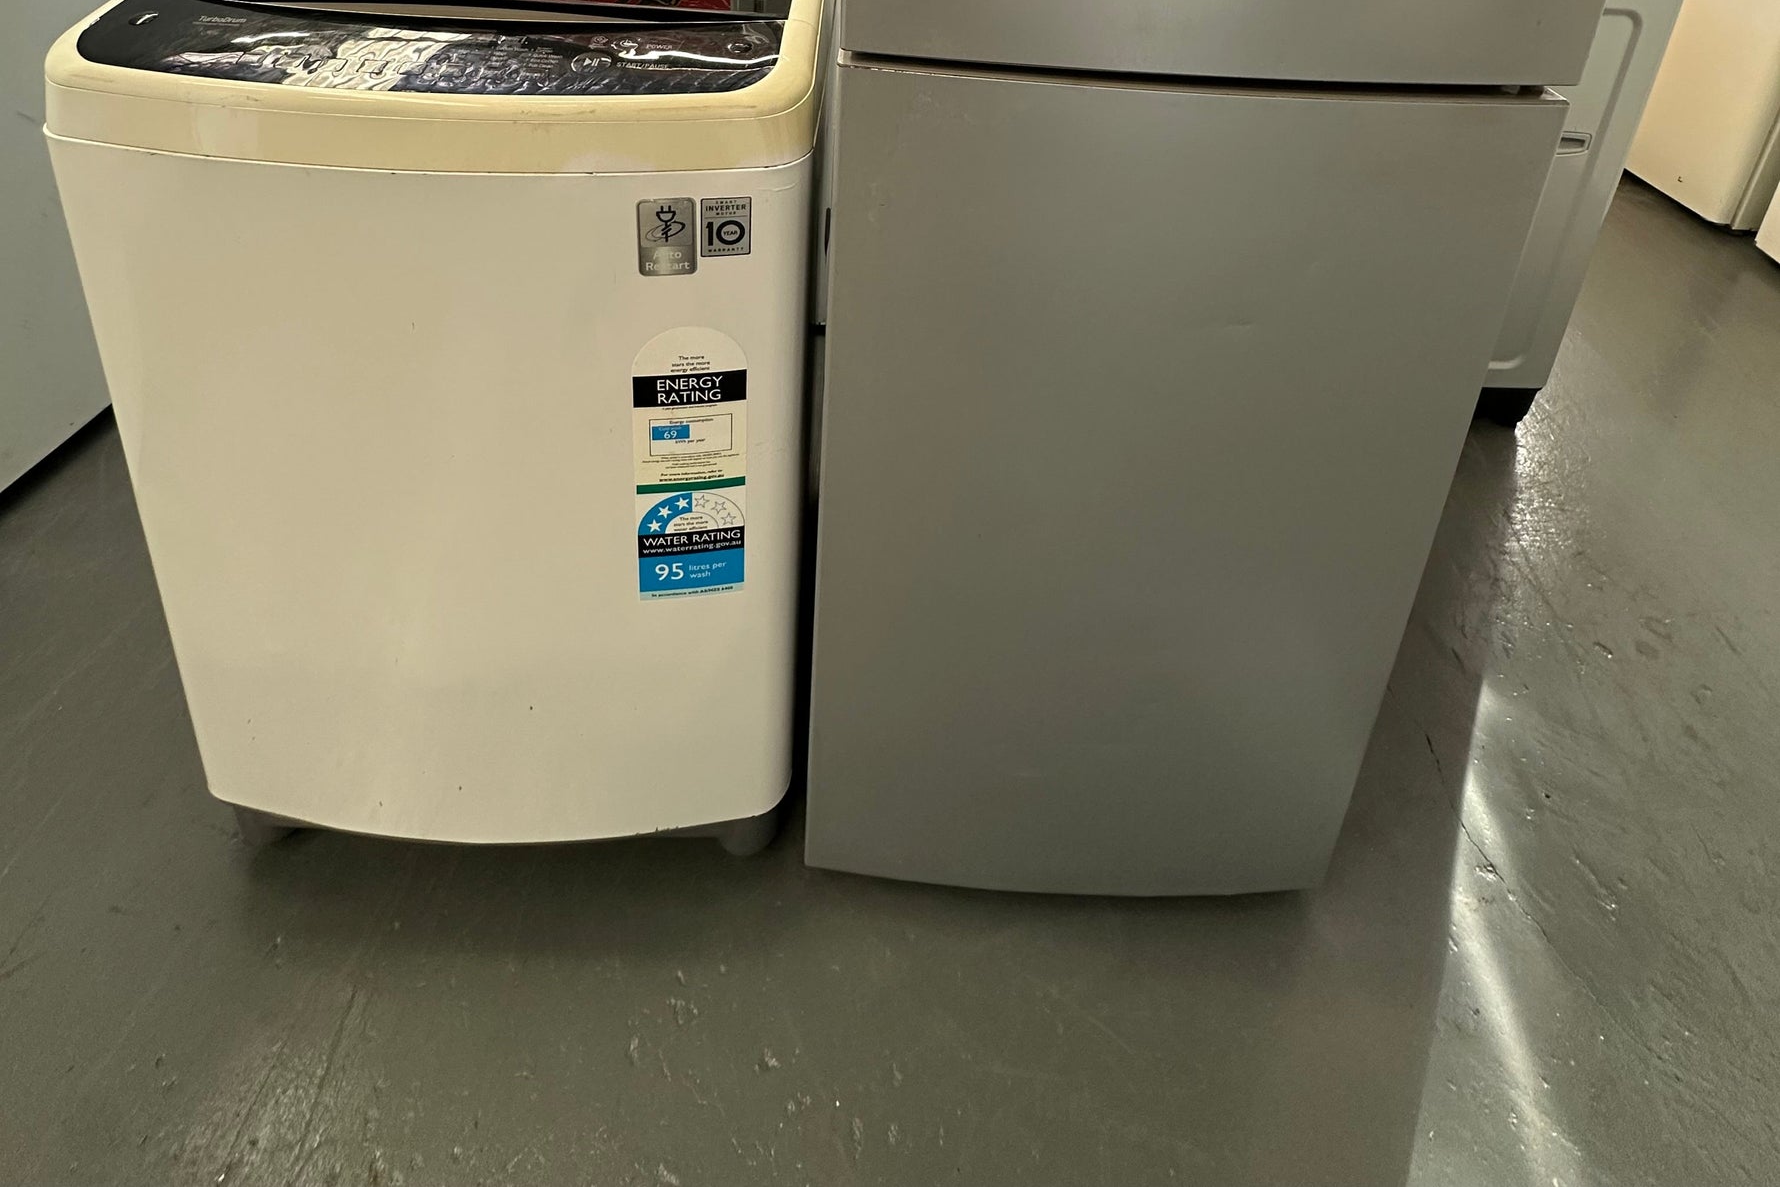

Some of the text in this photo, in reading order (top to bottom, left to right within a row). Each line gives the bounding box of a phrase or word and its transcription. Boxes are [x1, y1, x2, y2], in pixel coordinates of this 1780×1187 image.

[198, 15, 247, 23] TurboDrum
[706, 204, 747, 212] INVERTER
[706, 220, 746, 246] 10
[656, 375, 723, 391] ENERGY
[657, 389, 721, 404] RATING
[663, 430, 677, 439] 69
[643, 529, 741, 546] WATER RATING
[642, 540, 741, 554] www.waterrating.gov.au
[655, 562, 684, 581] 95
[712, 562, 727, 570] per
[690, 571, 711, 579] wash
